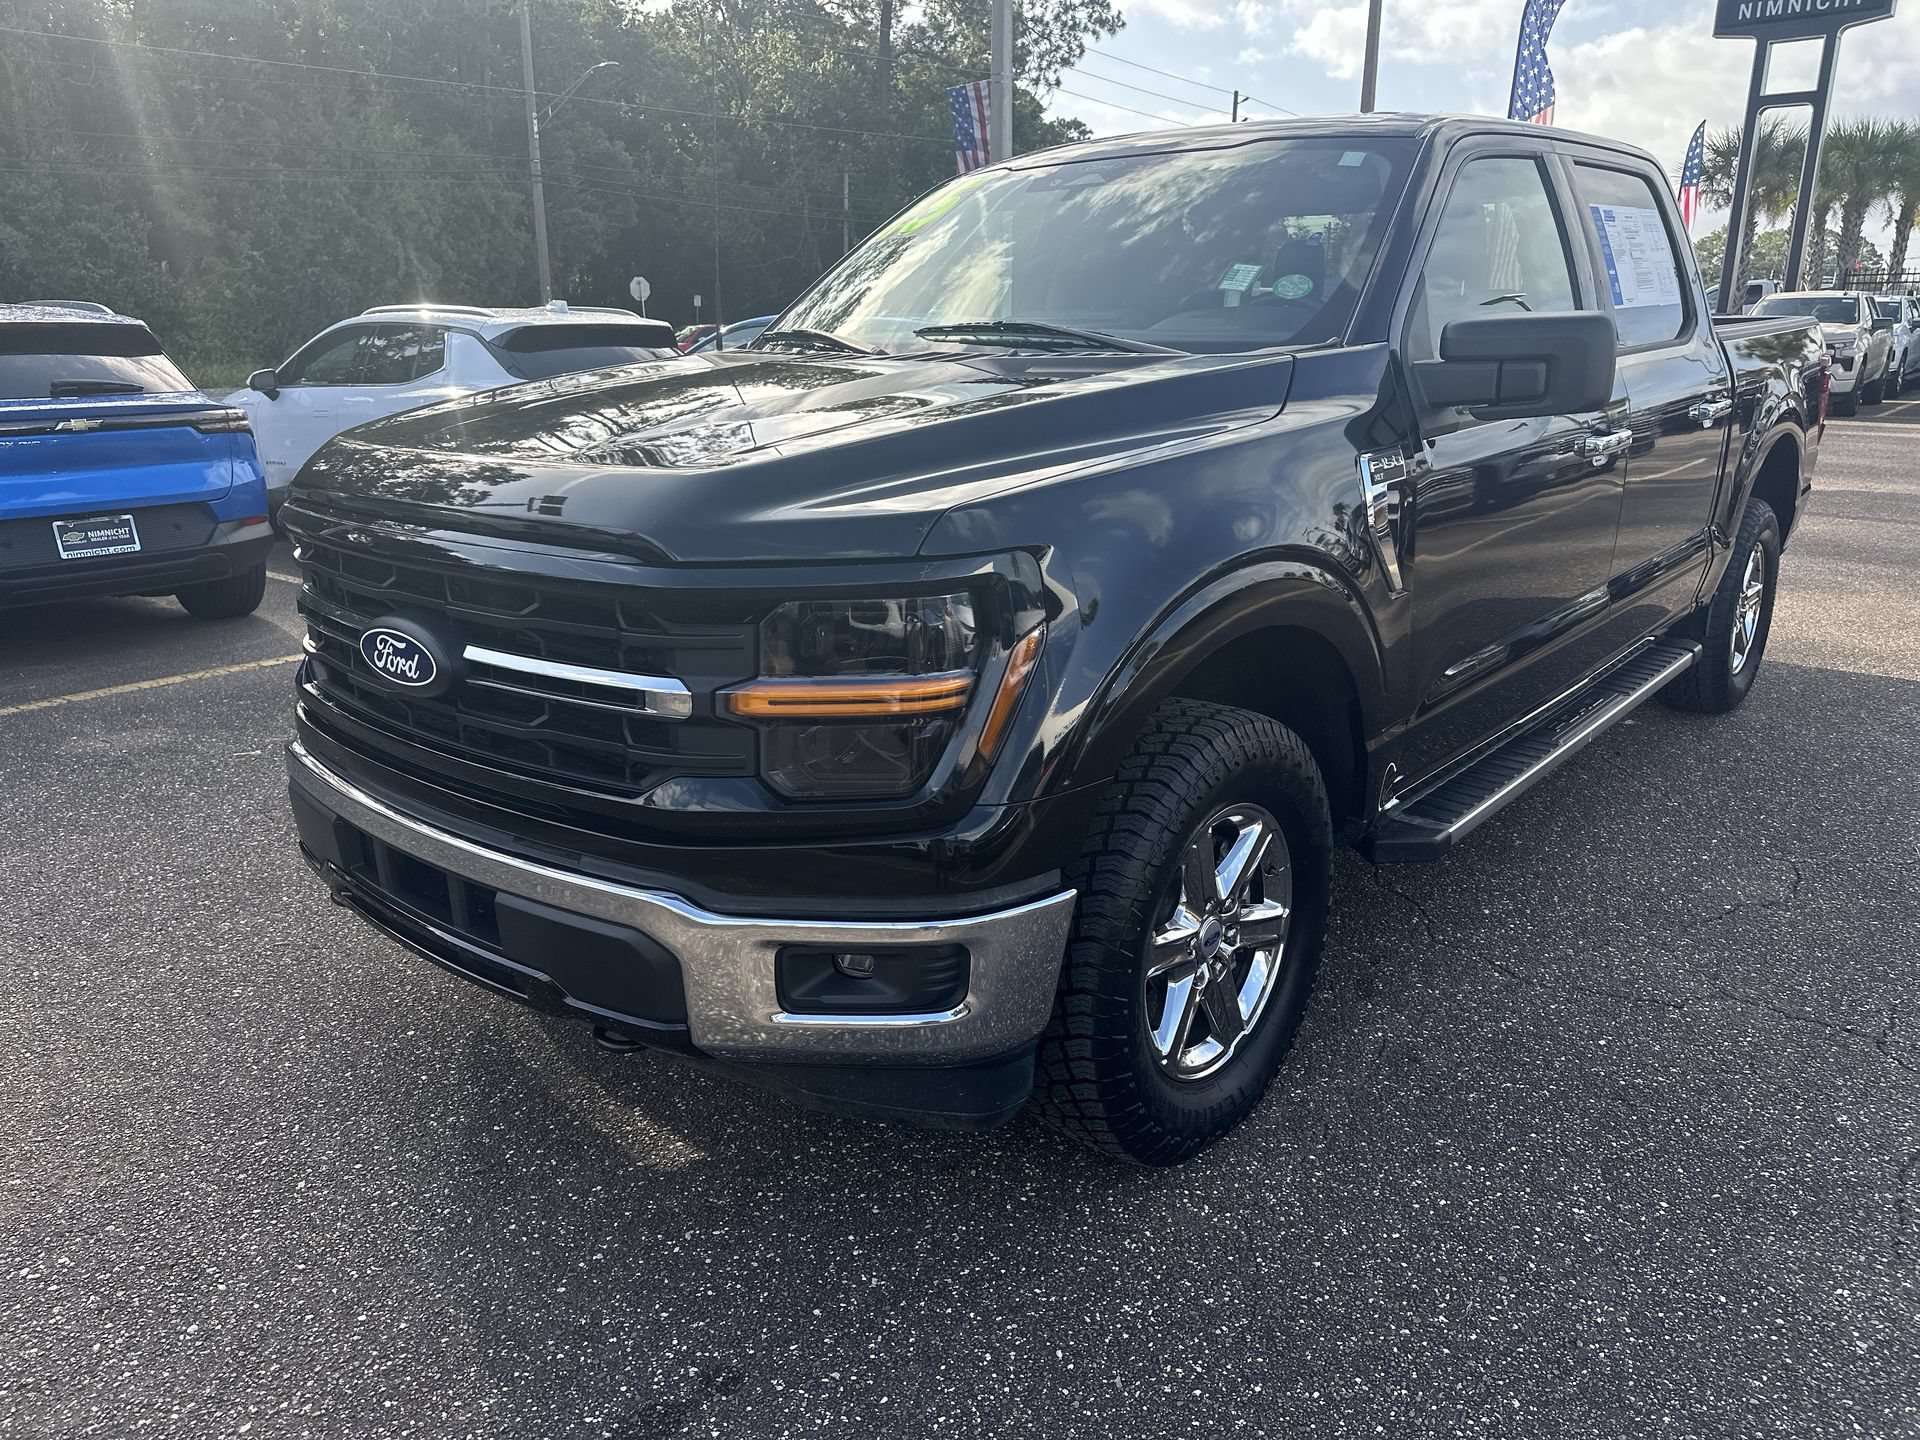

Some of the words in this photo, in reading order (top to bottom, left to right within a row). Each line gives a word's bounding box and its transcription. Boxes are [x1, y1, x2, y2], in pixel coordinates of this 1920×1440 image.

[1738, 0, 1862, 20] NIMNIC
[87, 527, 130, 539] NIMNICHT
[66, 544, 136, 558] nimnicht.com
[374, 634, 420, 679] Ford
